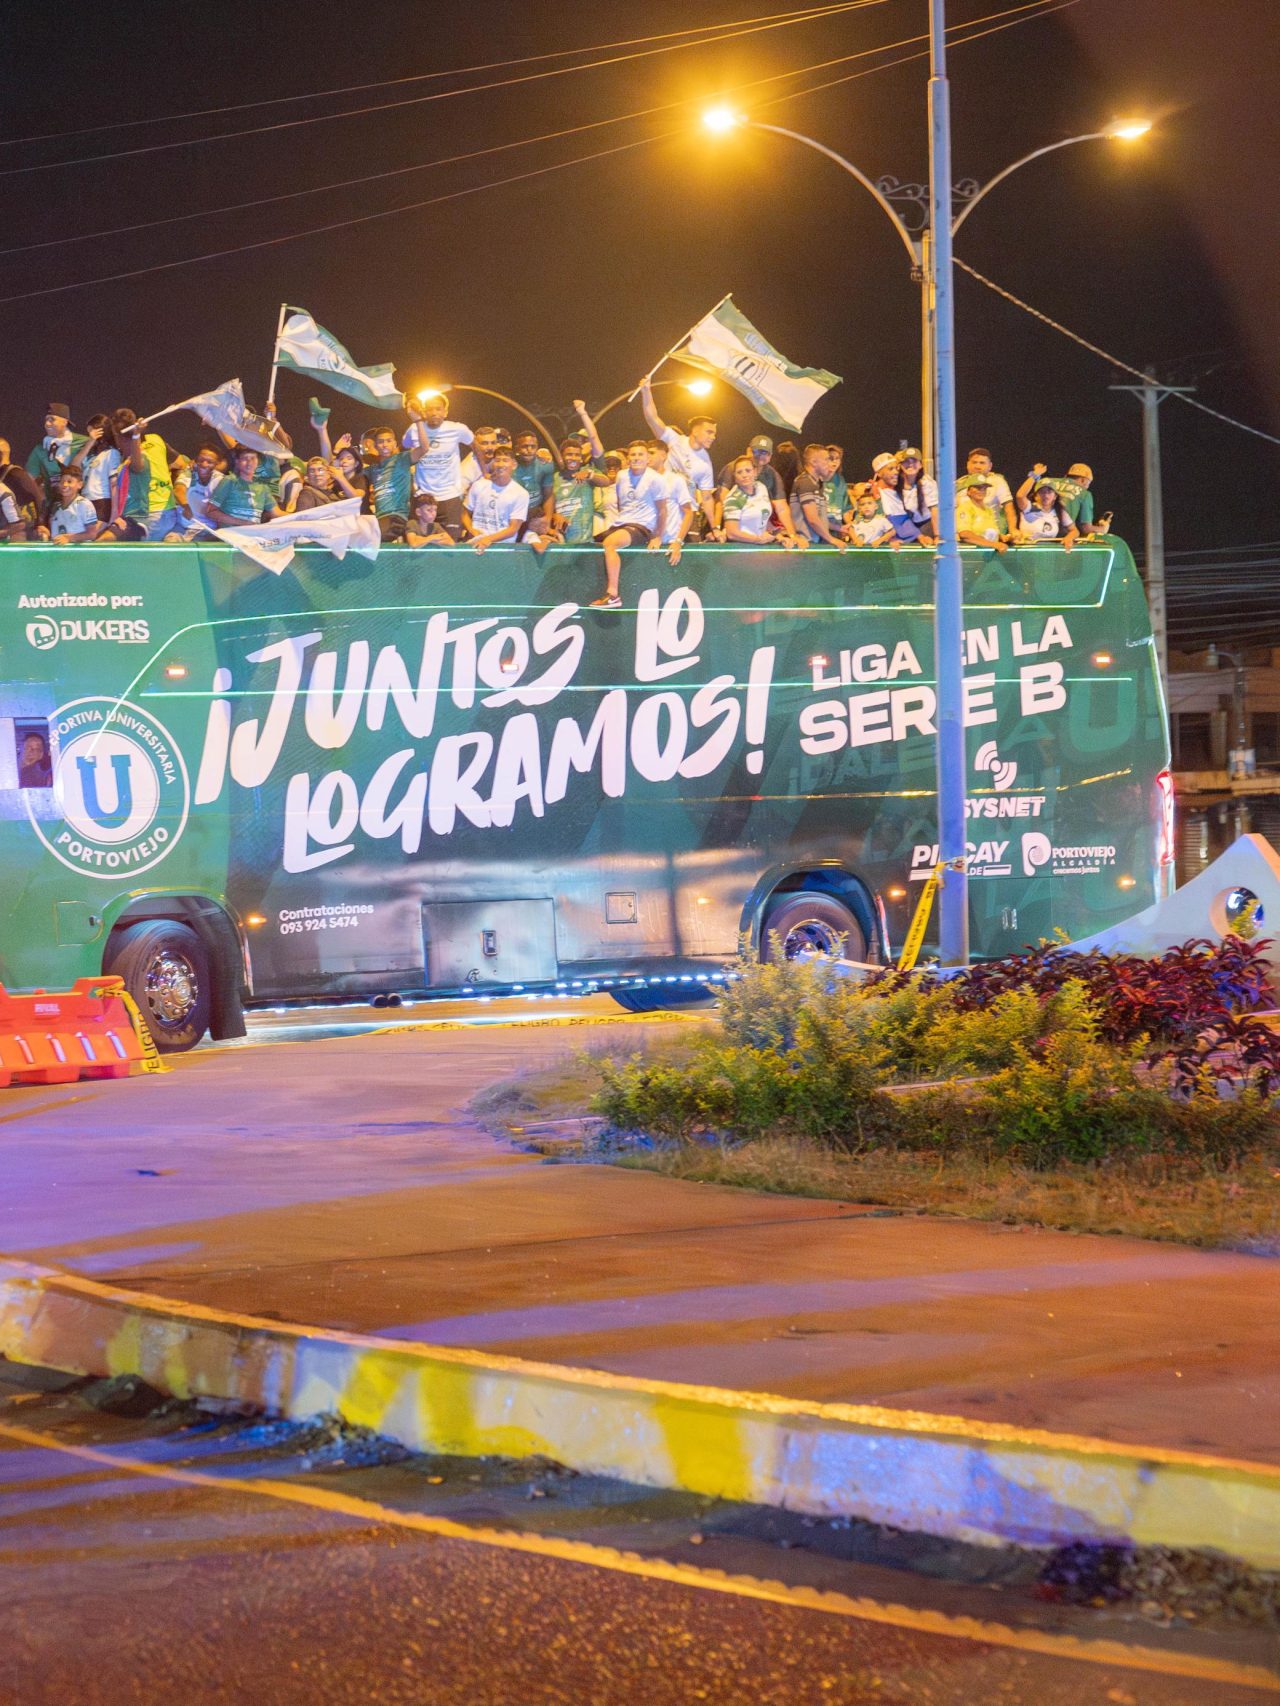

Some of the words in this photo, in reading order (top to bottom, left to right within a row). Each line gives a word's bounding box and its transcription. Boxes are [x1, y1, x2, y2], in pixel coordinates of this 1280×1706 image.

[18, 592, 108, 608] Autorizado
[111, 595, 143, 610] por:
[60, 619, 150, 642] DUKERS
[813, 640, 923, 691] LIGA
[1010, 614, 1074, 658] LA
[195, 602, 585, 804] ¡JUNTOS
[635, 586, 705, 681] LO
[798, 673, 997, 756] SERE
[1020, 660, 1067, 717] B
[49, 710, 103, 746] EPORTIVA
[106, 710, 176, 785] UNIVERSITARIA
[282, 646, 776, 873] LOGRAMOS!
[75, 754, 132, 830] U
[57, 827, 169, 868] PORTOVIEJO
[911, 840, 1009, 868] PICAY
[1052, 846, 1116, 858] PORTOVIEJO
[279, 903, 374, 921] Contrataciones
[280, 921, 303, 935] 093
[305, 918, 327, 931] 924
[329, 916, 359, 929] 5474
